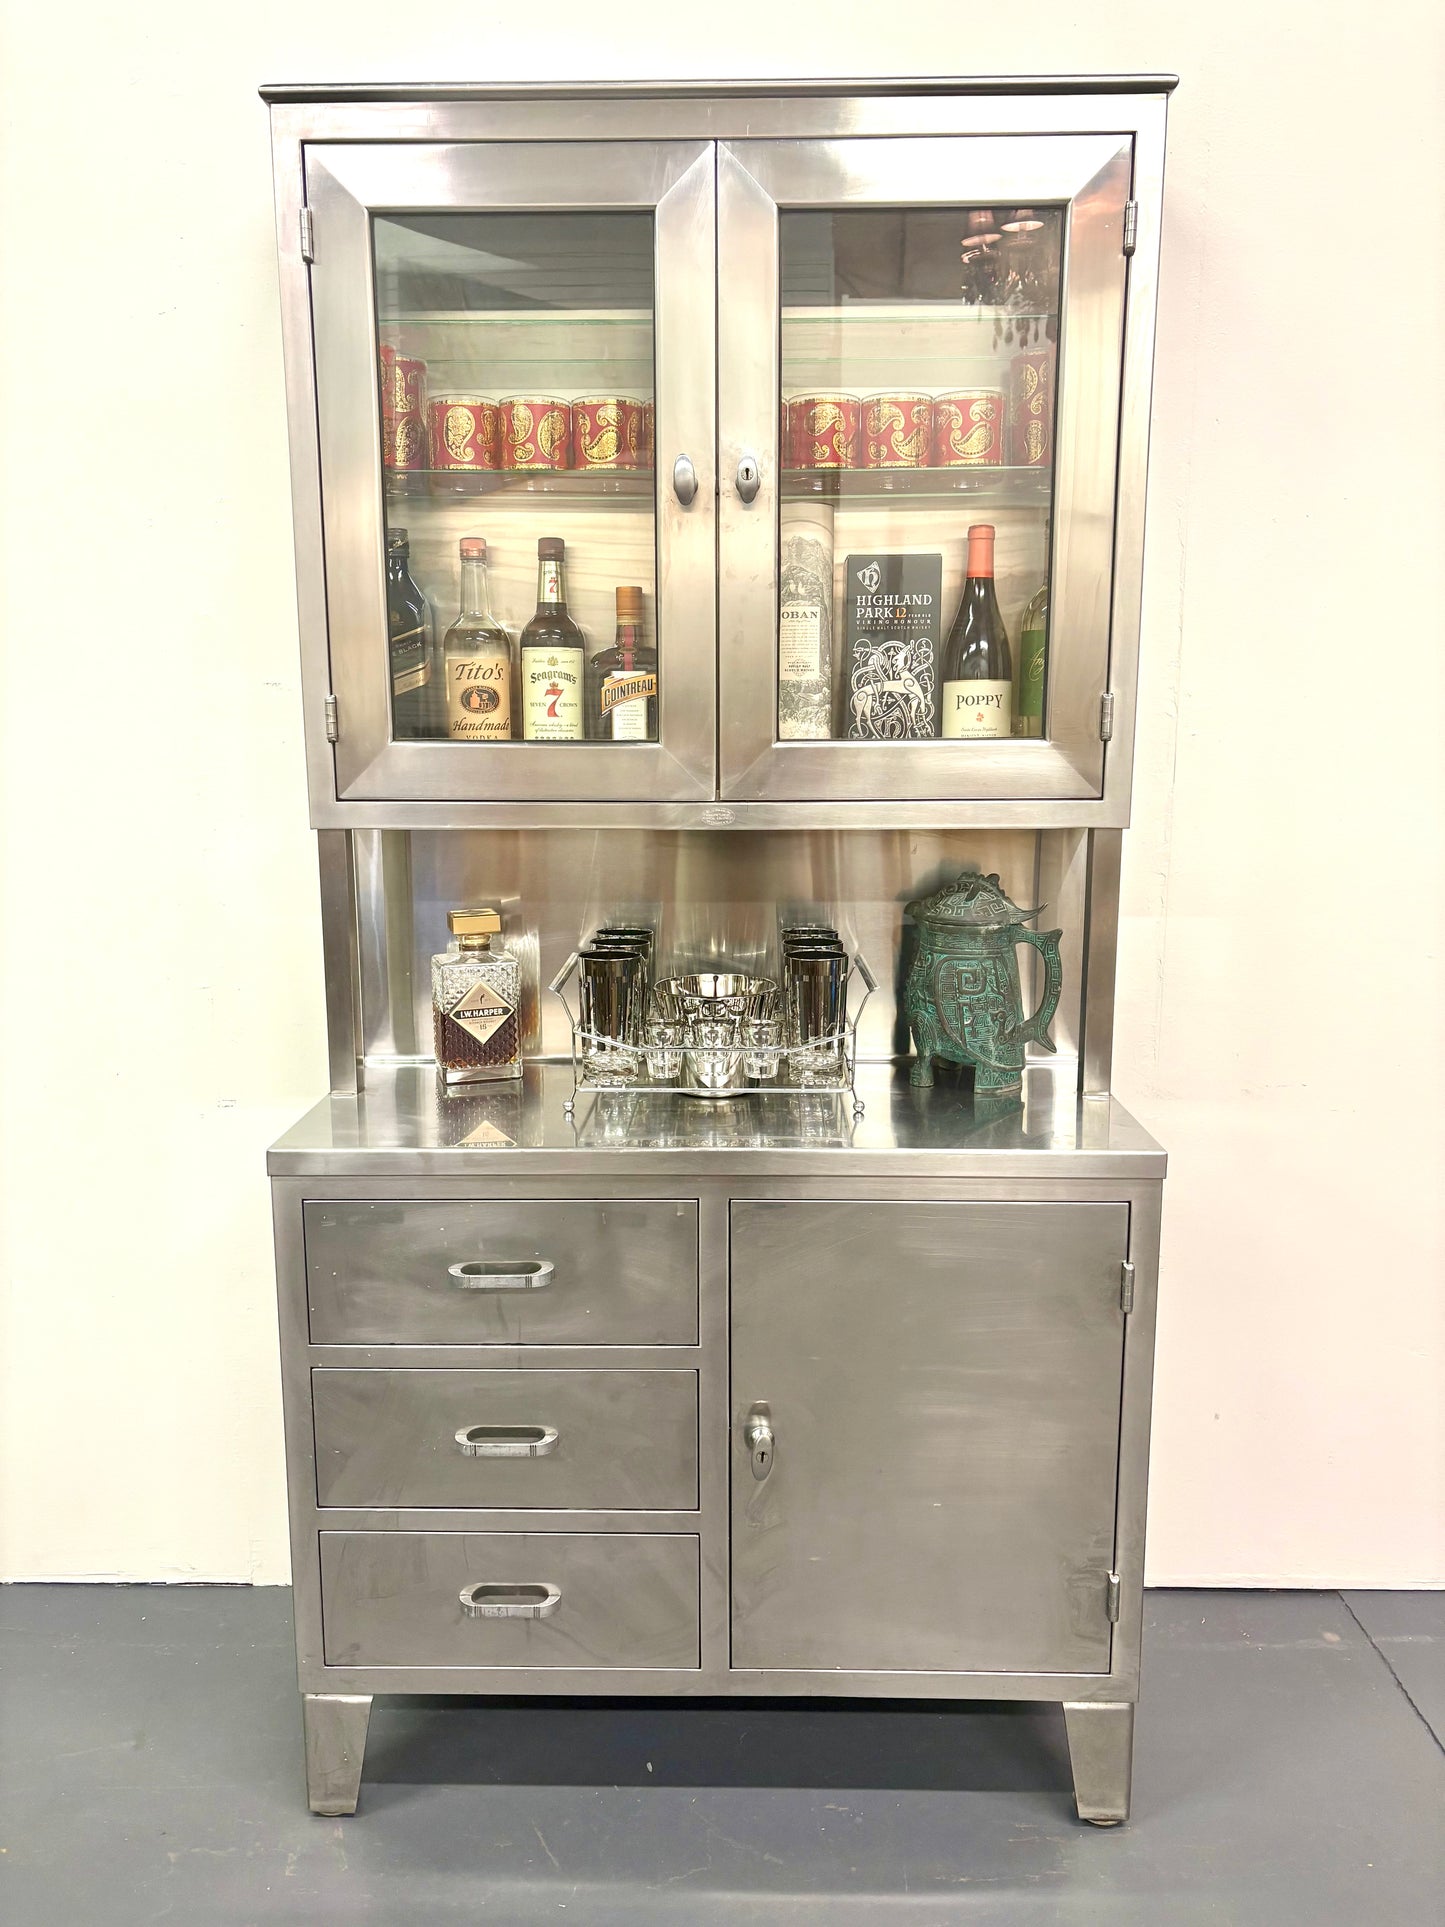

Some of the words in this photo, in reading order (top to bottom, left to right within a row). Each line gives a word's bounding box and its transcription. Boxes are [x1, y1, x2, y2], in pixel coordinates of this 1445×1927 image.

[856, 594, 933, 606] HIGHLAND
[781, 611, 818, 619] OBAN
[856, 607, 894, 620] PARK
[895, 607, 907, 618] 12
[398, 641, 422, 655] BLACK
[455, 661, 504, 681] Tito's
[530, 670, 578, 685] Seagram's
[604, 678, 653, 707] COINTREAU
[544, 688, 564, 718] 7
[956, 694, 1003, 710] POPPY
